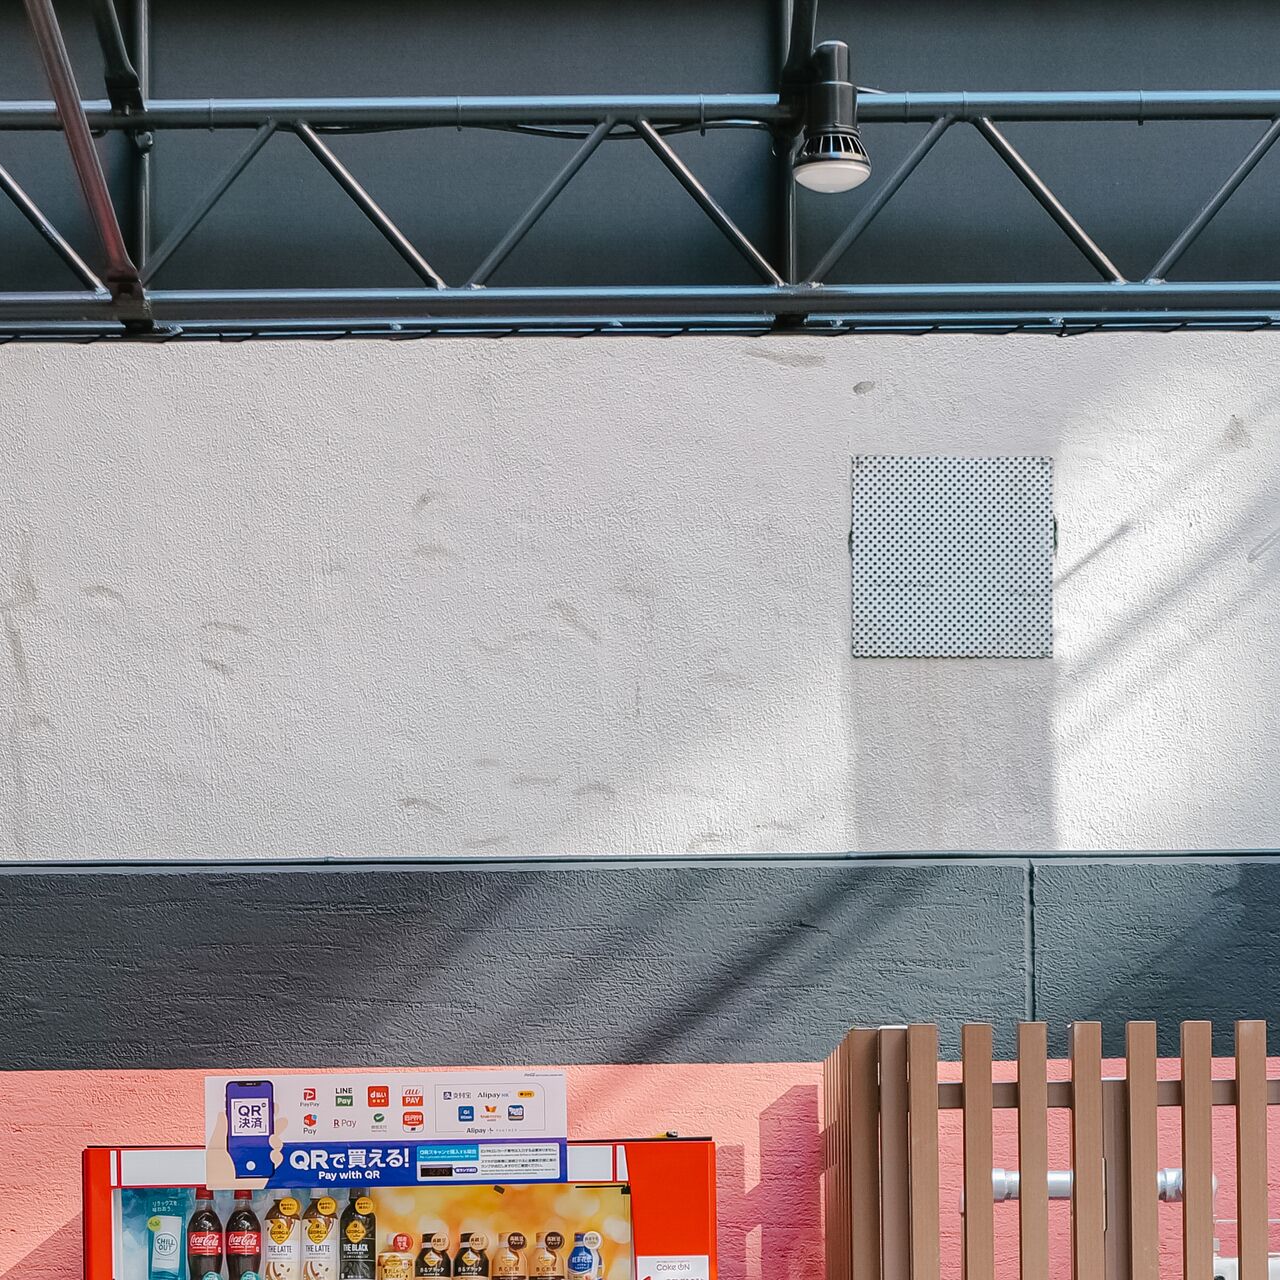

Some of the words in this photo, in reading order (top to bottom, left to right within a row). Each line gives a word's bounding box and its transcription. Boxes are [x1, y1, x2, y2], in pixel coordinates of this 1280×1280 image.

[477, 1092, 501, 1100] Alipay
[337, 1097, 352, 1105] Pay
[238, 1105, 262, 1117] QR
[239, 1118, 262, 1129] 決済
[341, 1119, 357, 1128] Pay
[289, 1148, 410, 1170] QRで買える!
[319, 1172, 335, 1181] Pay
[338, 1171, 363, 1180] with
[365, 1171, 380, 1180] QR
[277, 1245, 292, 1253] LATTE
[351, 1244, 368, 1252] BLACK
